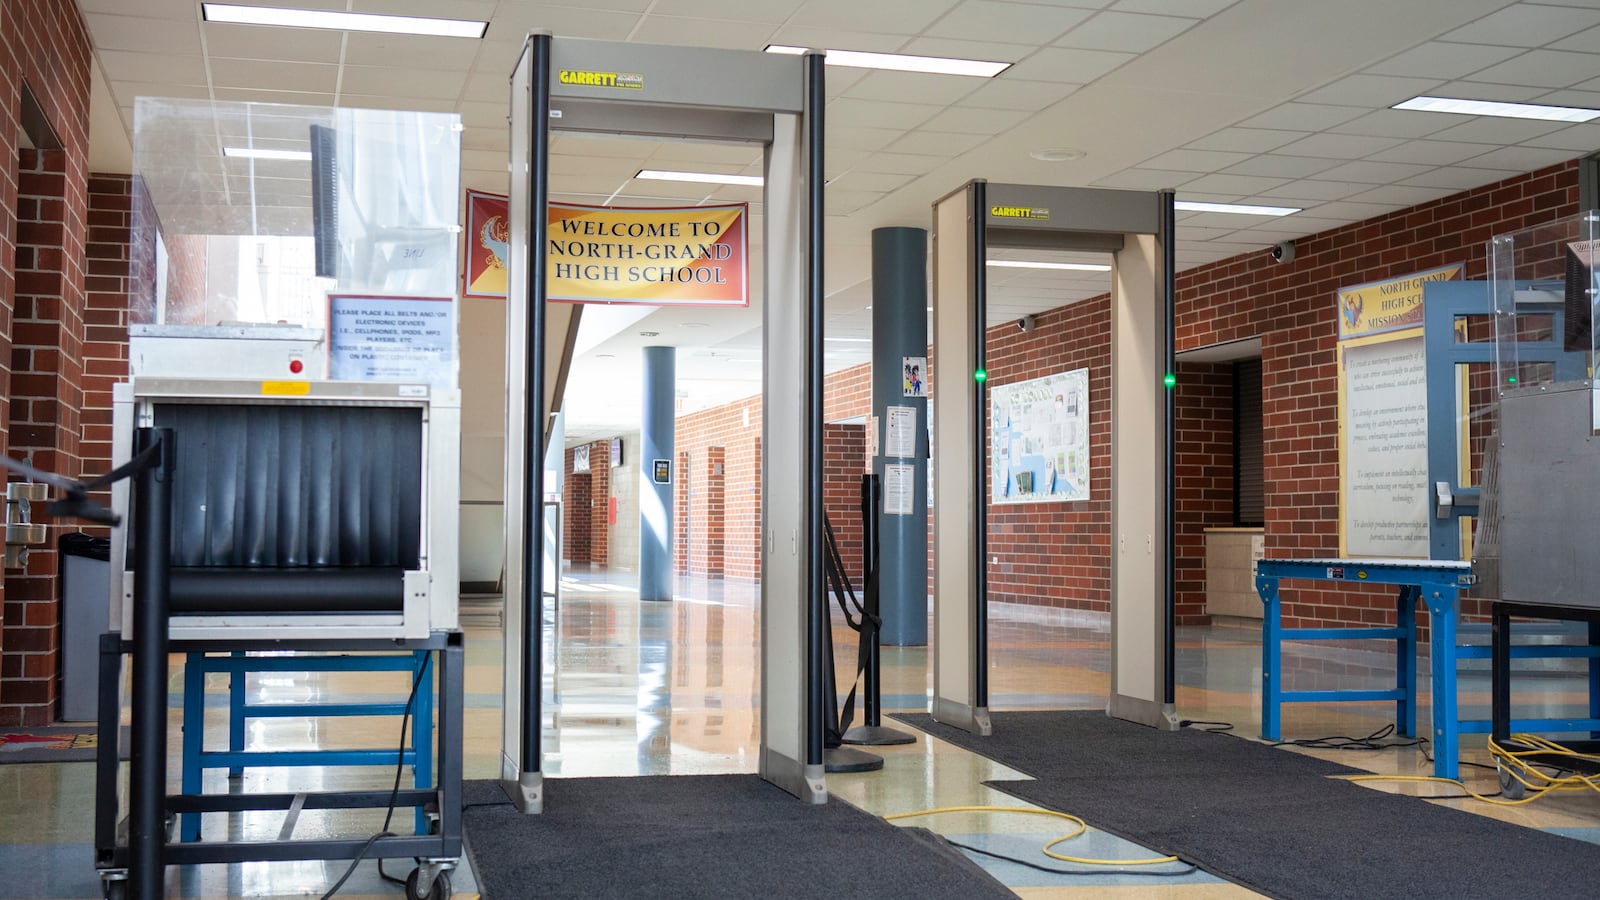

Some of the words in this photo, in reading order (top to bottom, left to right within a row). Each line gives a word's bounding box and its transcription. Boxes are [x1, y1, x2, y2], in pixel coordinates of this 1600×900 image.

[560, 71, 617, 86] GARRETT
[992, 207, 1031, 218] GARRETT
[560, 218, 680, 238] WELCOME
[688, 221, 721, 237] TO
[549, 239, 732, 261] NORTH-GRAND
[555, 262, 620, 282] HIGH
[628, 266, 727, 284] SCHOOL
[1380, 280, 1410, 297] NORTH
[1381, 298, 1405, 311] HIGH
[1368, 313, 1405, 329] MISSION
